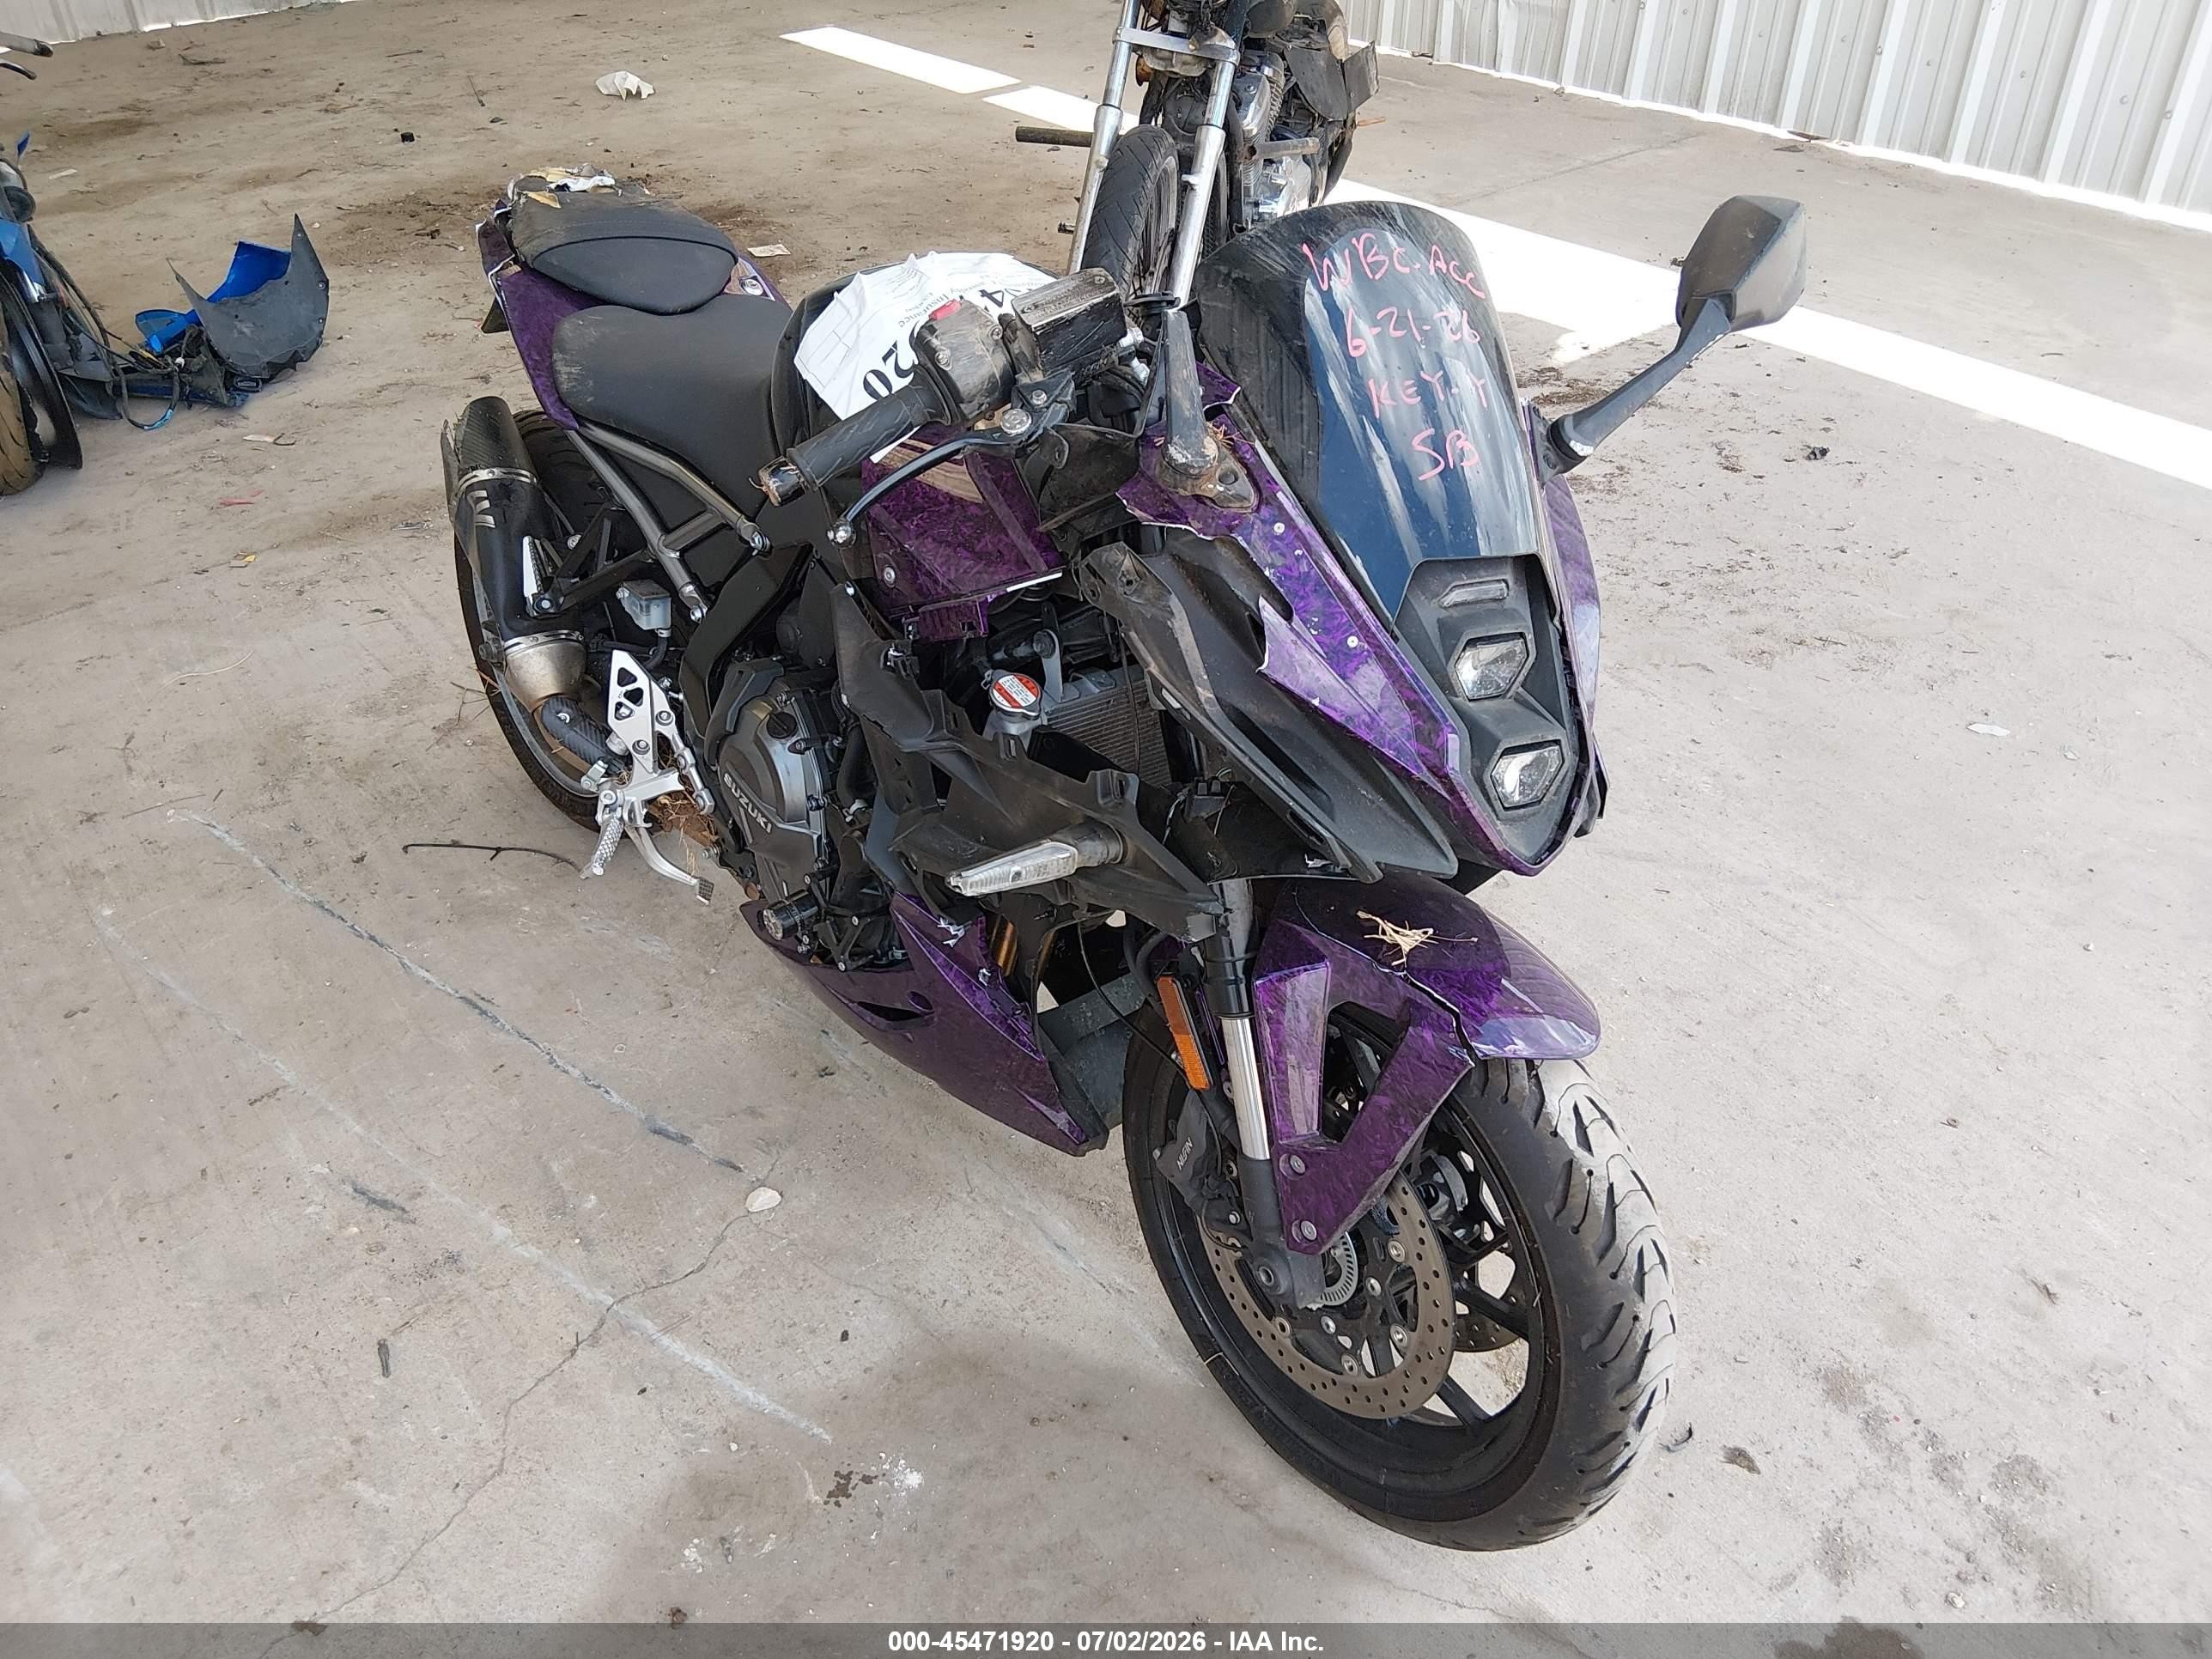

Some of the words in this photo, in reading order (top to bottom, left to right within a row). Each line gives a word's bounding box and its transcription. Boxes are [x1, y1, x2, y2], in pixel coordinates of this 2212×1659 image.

[862, 321, 919, 401] 20
[1346, 306, 1481, 358] 6-21-26
[723, 772, 773, 834] SUZUKI
